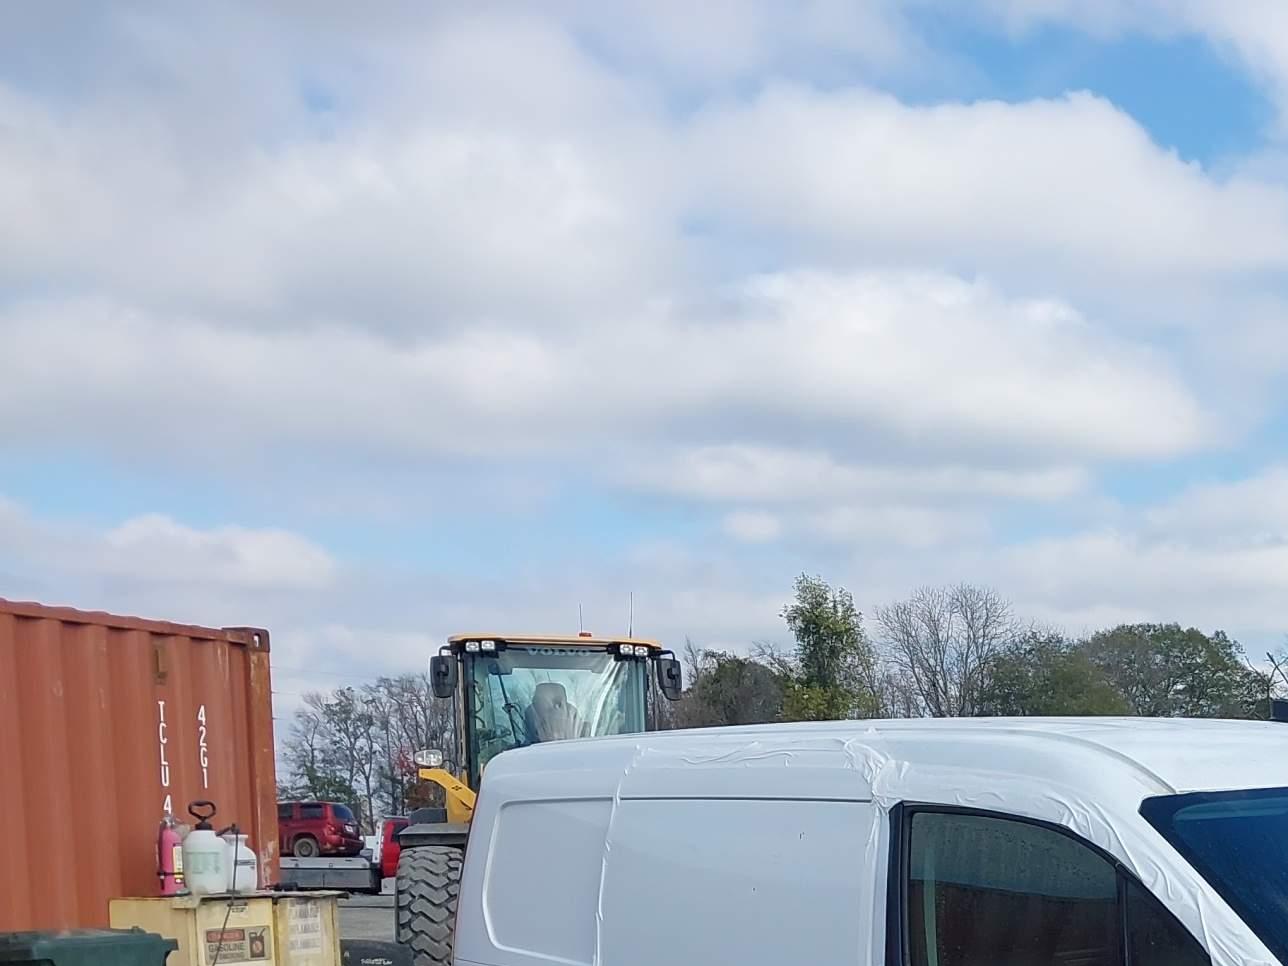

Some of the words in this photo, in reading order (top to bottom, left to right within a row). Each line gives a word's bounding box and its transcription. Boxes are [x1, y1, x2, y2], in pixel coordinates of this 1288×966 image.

[157, 700, 169, 787] TCLU
[197, 704, 208, 789] 42G1
[208, 942, 246, 953] GASOLINE
